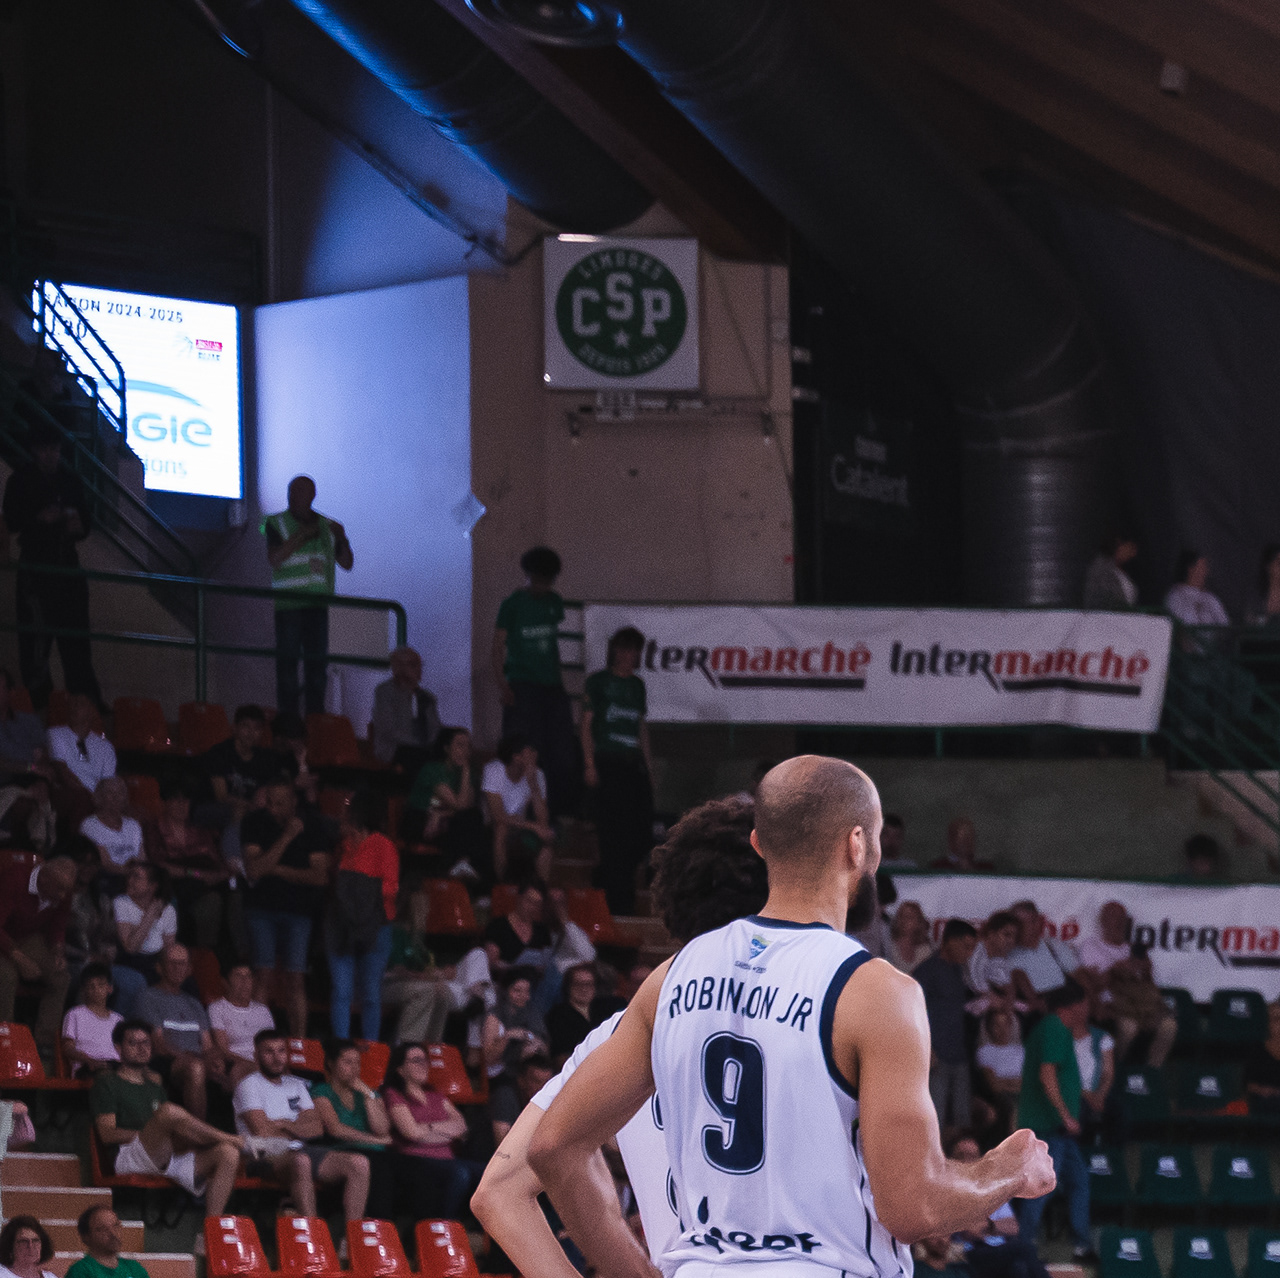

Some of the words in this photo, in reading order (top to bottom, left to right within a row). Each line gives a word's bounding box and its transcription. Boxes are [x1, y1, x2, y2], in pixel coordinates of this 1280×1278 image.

[572, 271, 671, 338] CSP
[645, 640, 873, 690] termarché
[776, 993, 813, 1032] JR
[702, 1030, 767, 1176] 9
